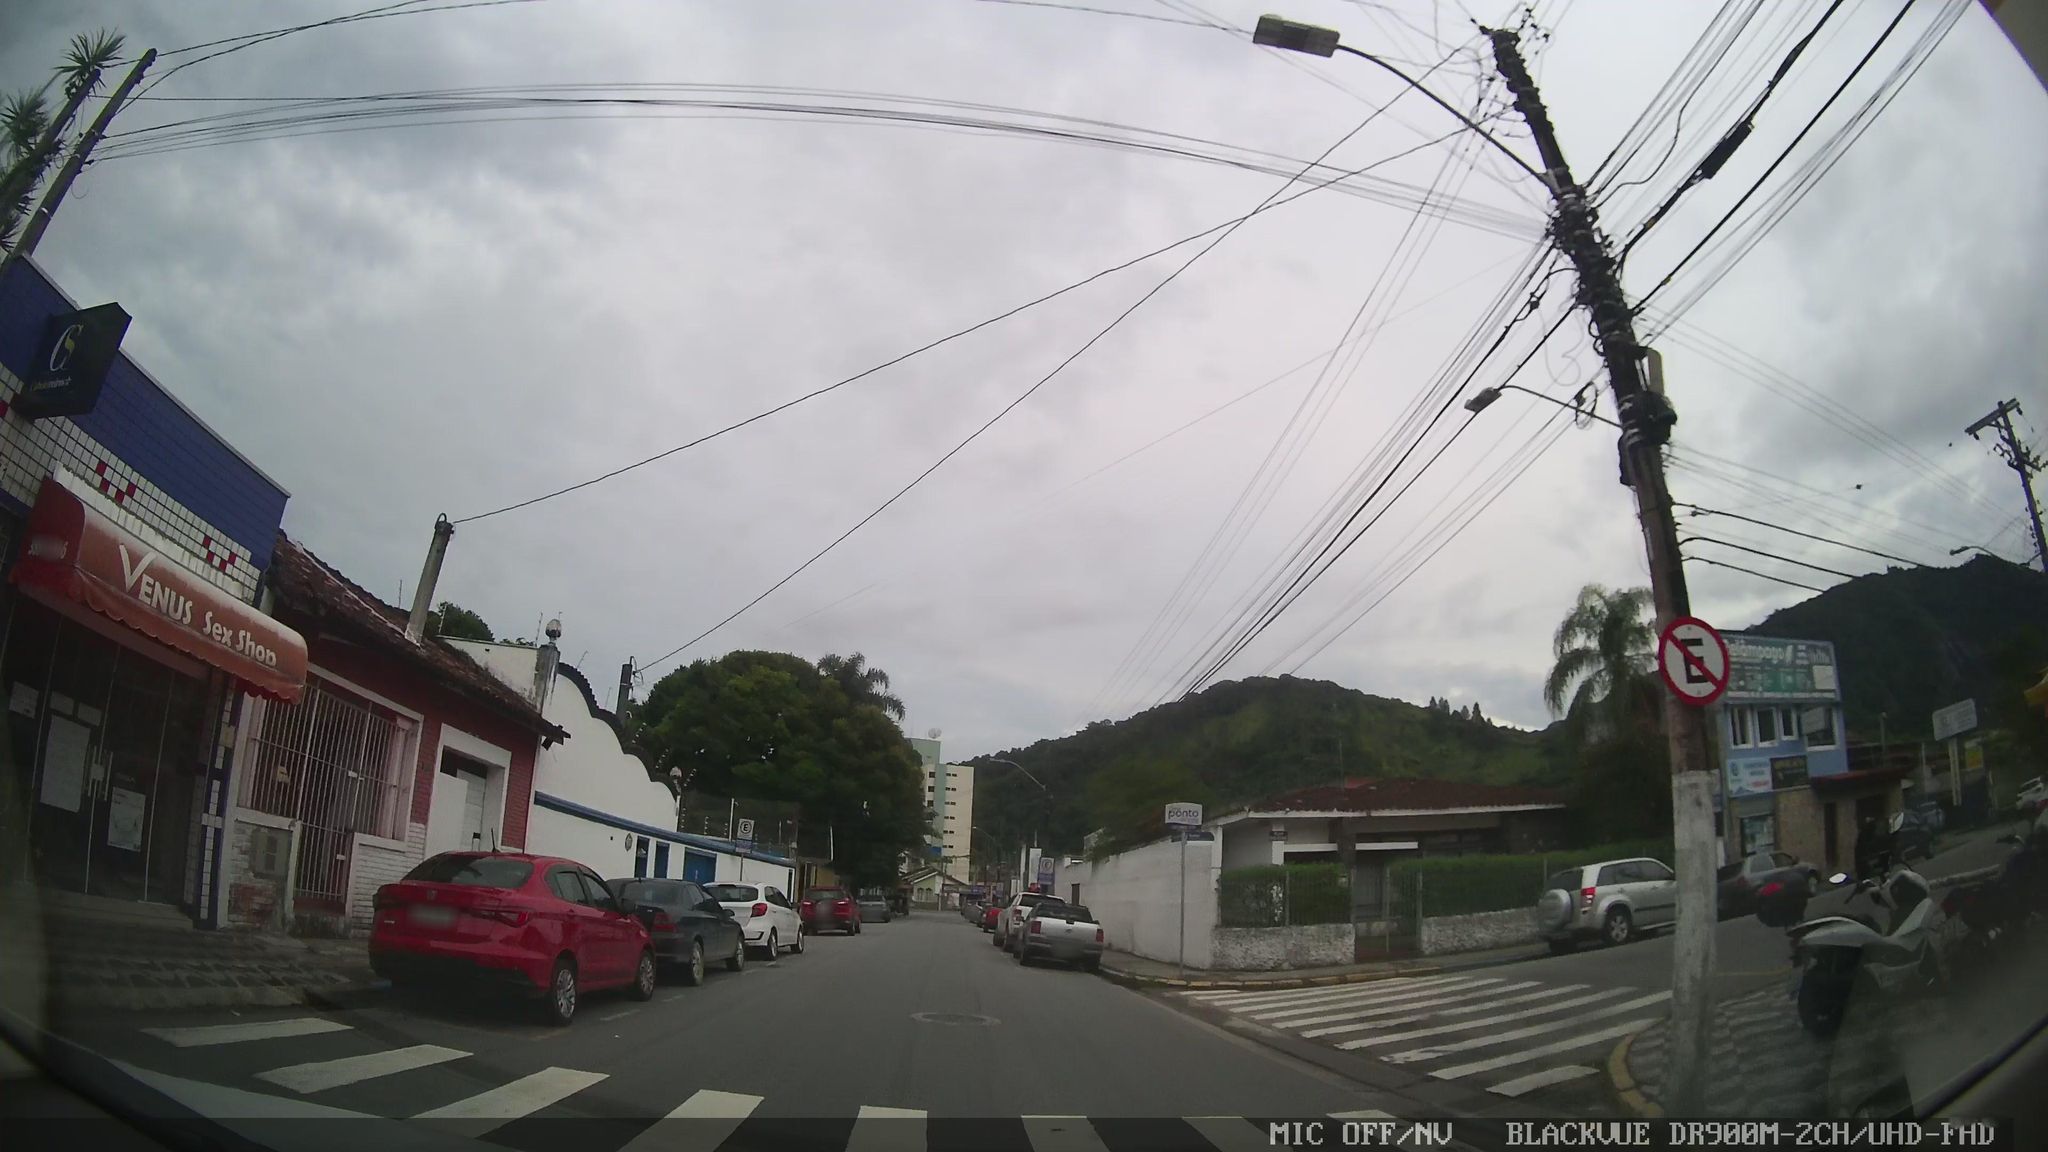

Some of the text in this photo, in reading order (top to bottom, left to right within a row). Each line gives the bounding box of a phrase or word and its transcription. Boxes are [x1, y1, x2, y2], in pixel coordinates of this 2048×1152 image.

[119, 543, 277, 666] VENUS Sex Shop
[1681, 638, 1710, 684] E
[1168, 809, 1199, 820] ponto
